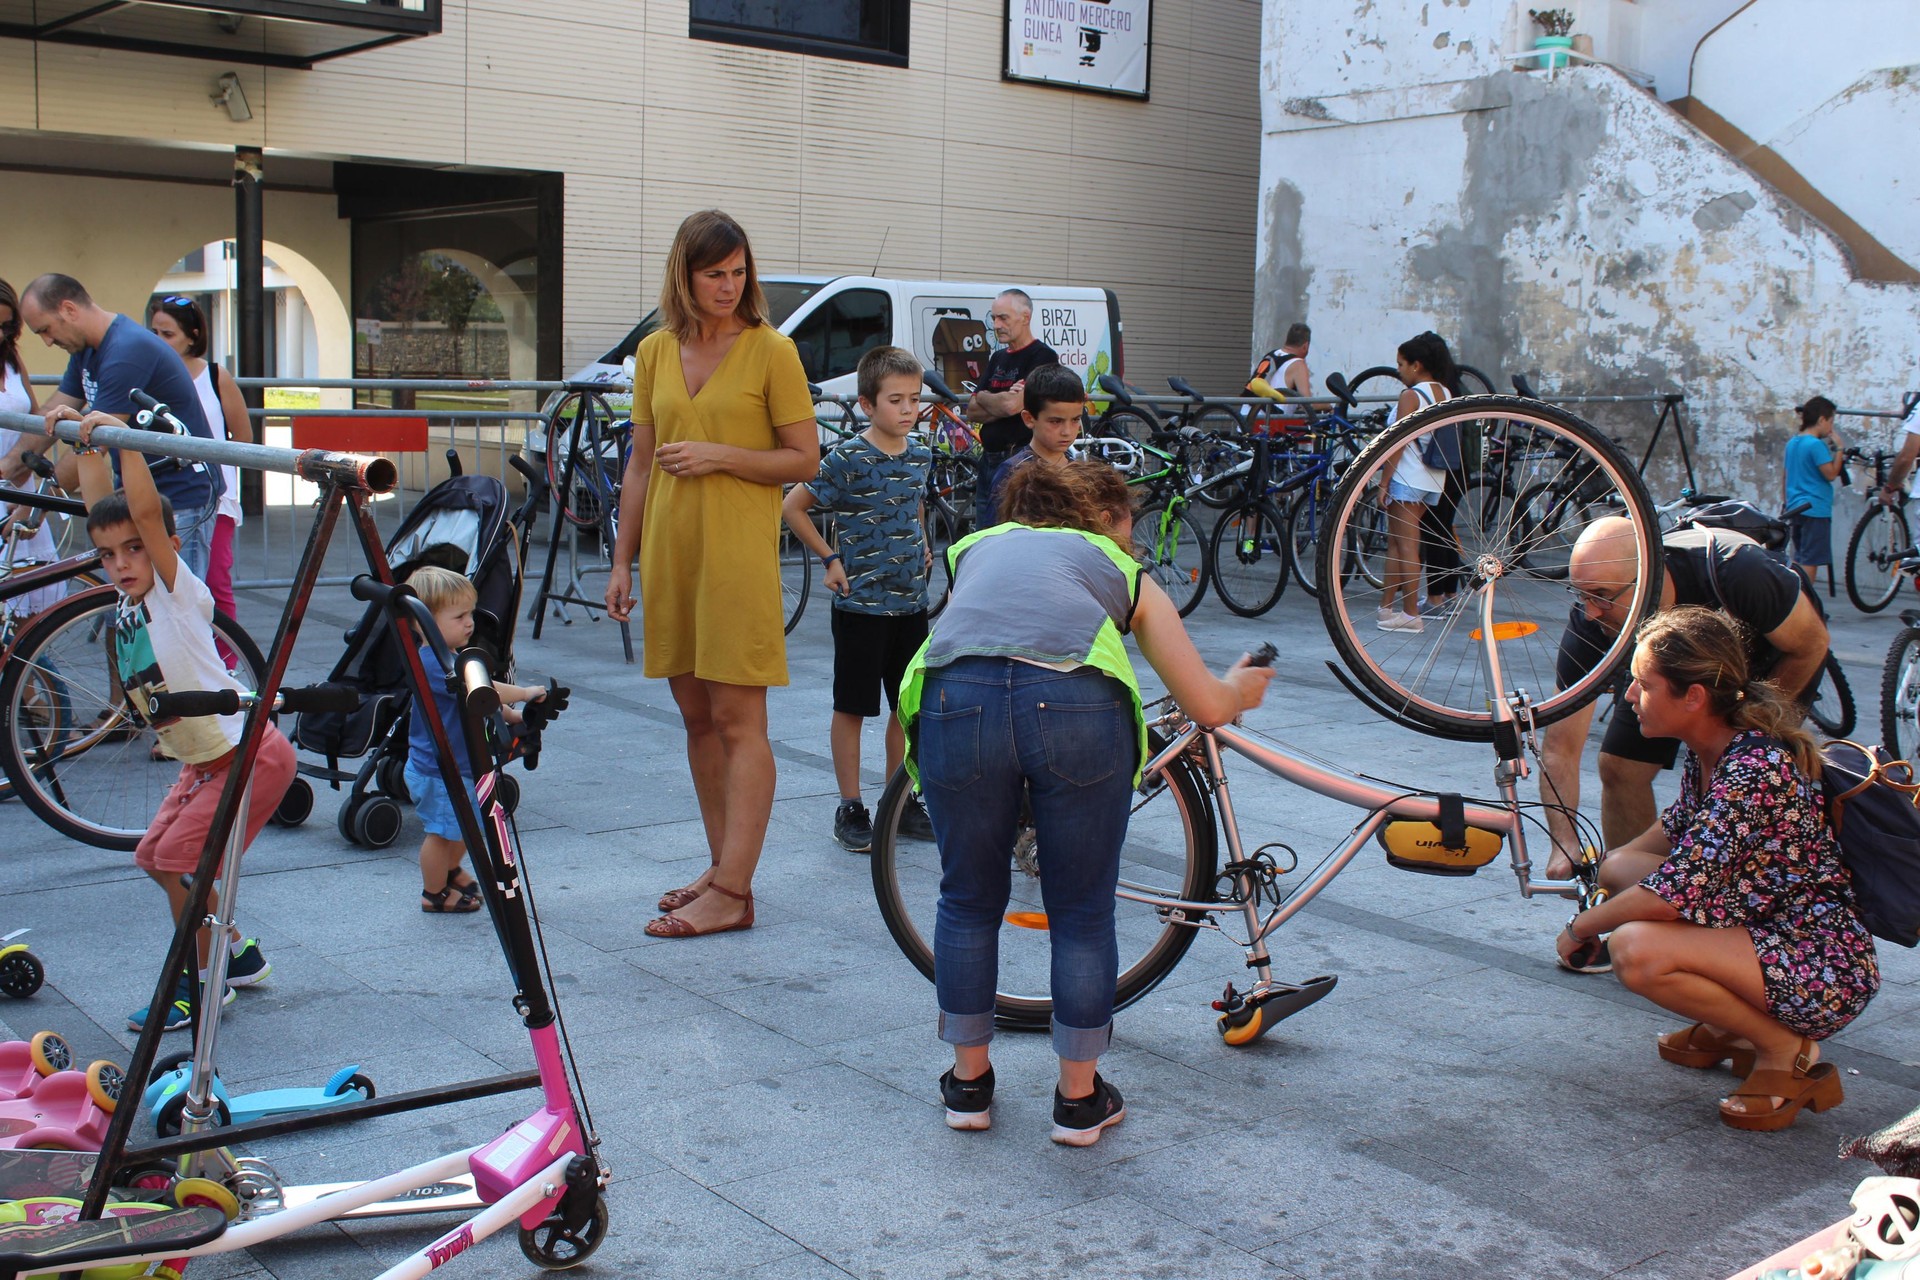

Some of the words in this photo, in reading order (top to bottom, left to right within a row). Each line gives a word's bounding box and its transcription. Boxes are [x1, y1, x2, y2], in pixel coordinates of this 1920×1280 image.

[1025, 0, 1075, 22] ANTONIO
[1080, 4, 1131, 31] MERCERO
[1024, 18, 1062, 43] GUNEA
[1041, 308, 1076, 326] BIRZI
[1043, 328, 1087, 347] KLATU
[1057, 349, 1087, 366] cicla
